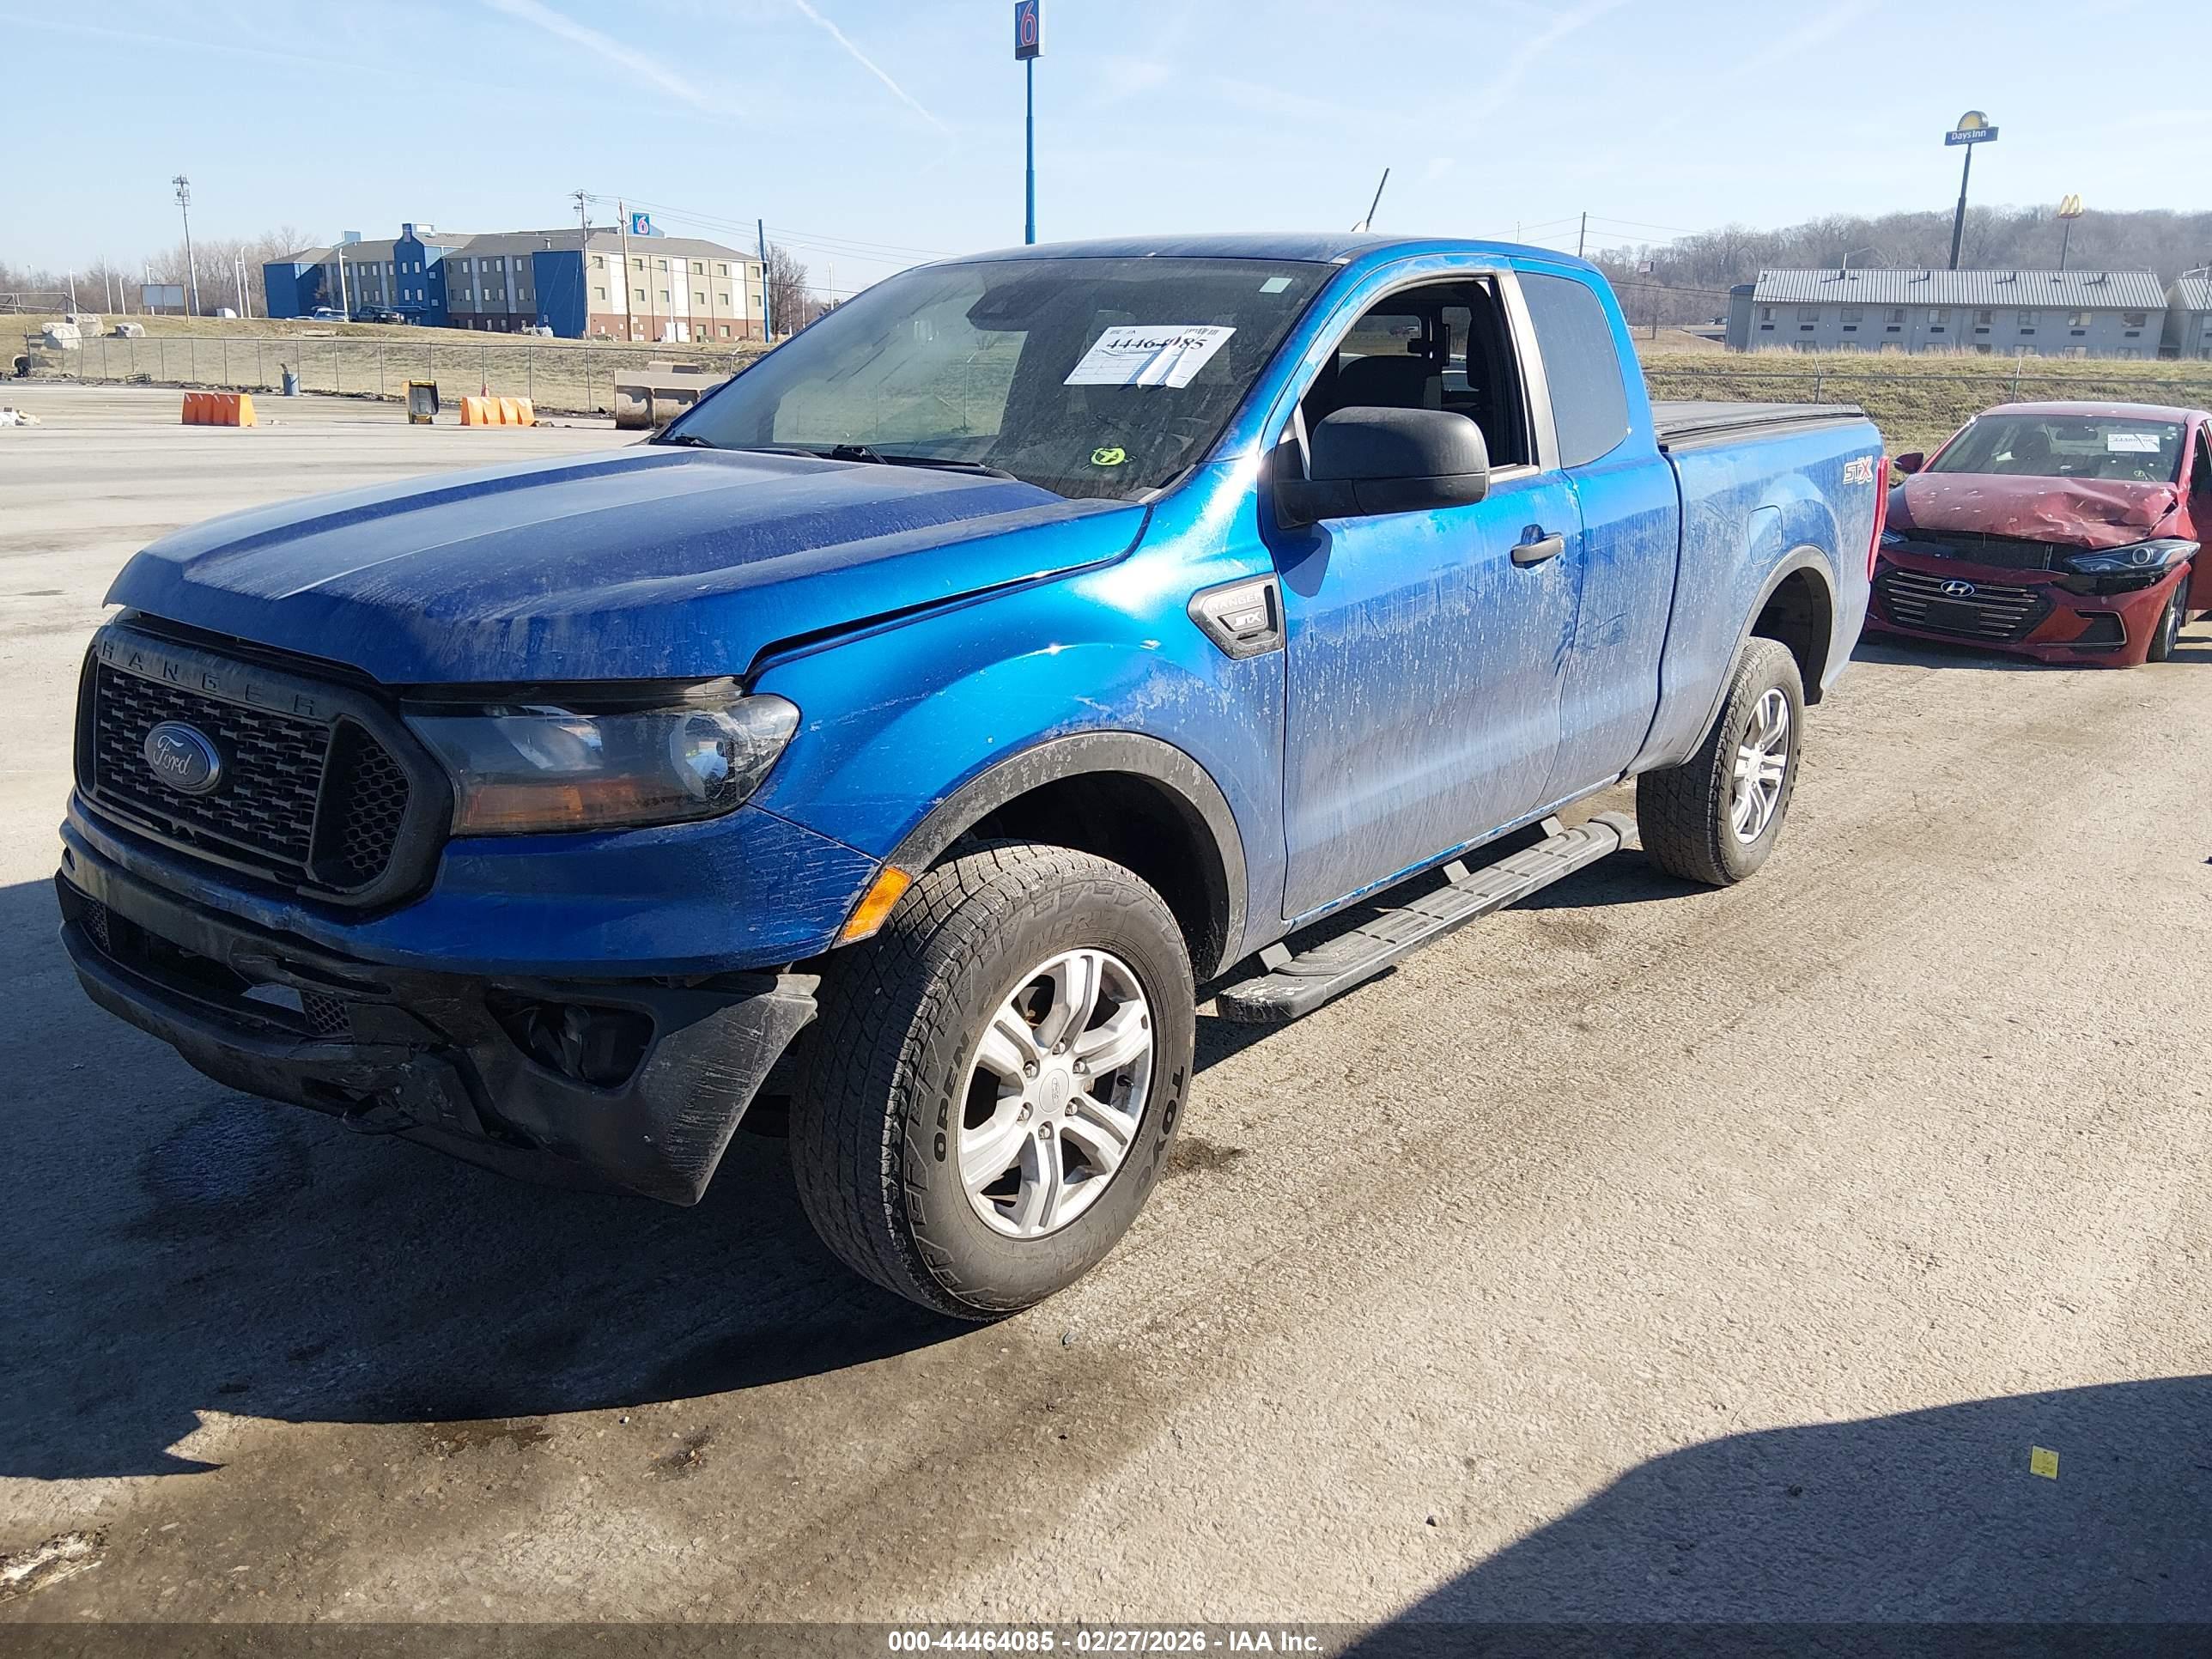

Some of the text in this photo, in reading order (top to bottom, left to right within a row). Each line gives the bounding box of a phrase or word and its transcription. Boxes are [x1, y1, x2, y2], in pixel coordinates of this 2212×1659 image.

[1020, 1, 1037, 46] 6
[1951, 130, 1986, 141] Days Inn
[637, 216, 649, 234] 6
[1843, 455, 1874, 484] STX
[1207, 591, 1263, 613] RANGER
[1233, 611, 1262, 627] STX
[101, 641, 316, 717] RANGER
[152, 735, 193, 776] Ford
[933, 1030, 970, 1163] OPEN
[1133, 1065, 1185, 1200] TOYO
